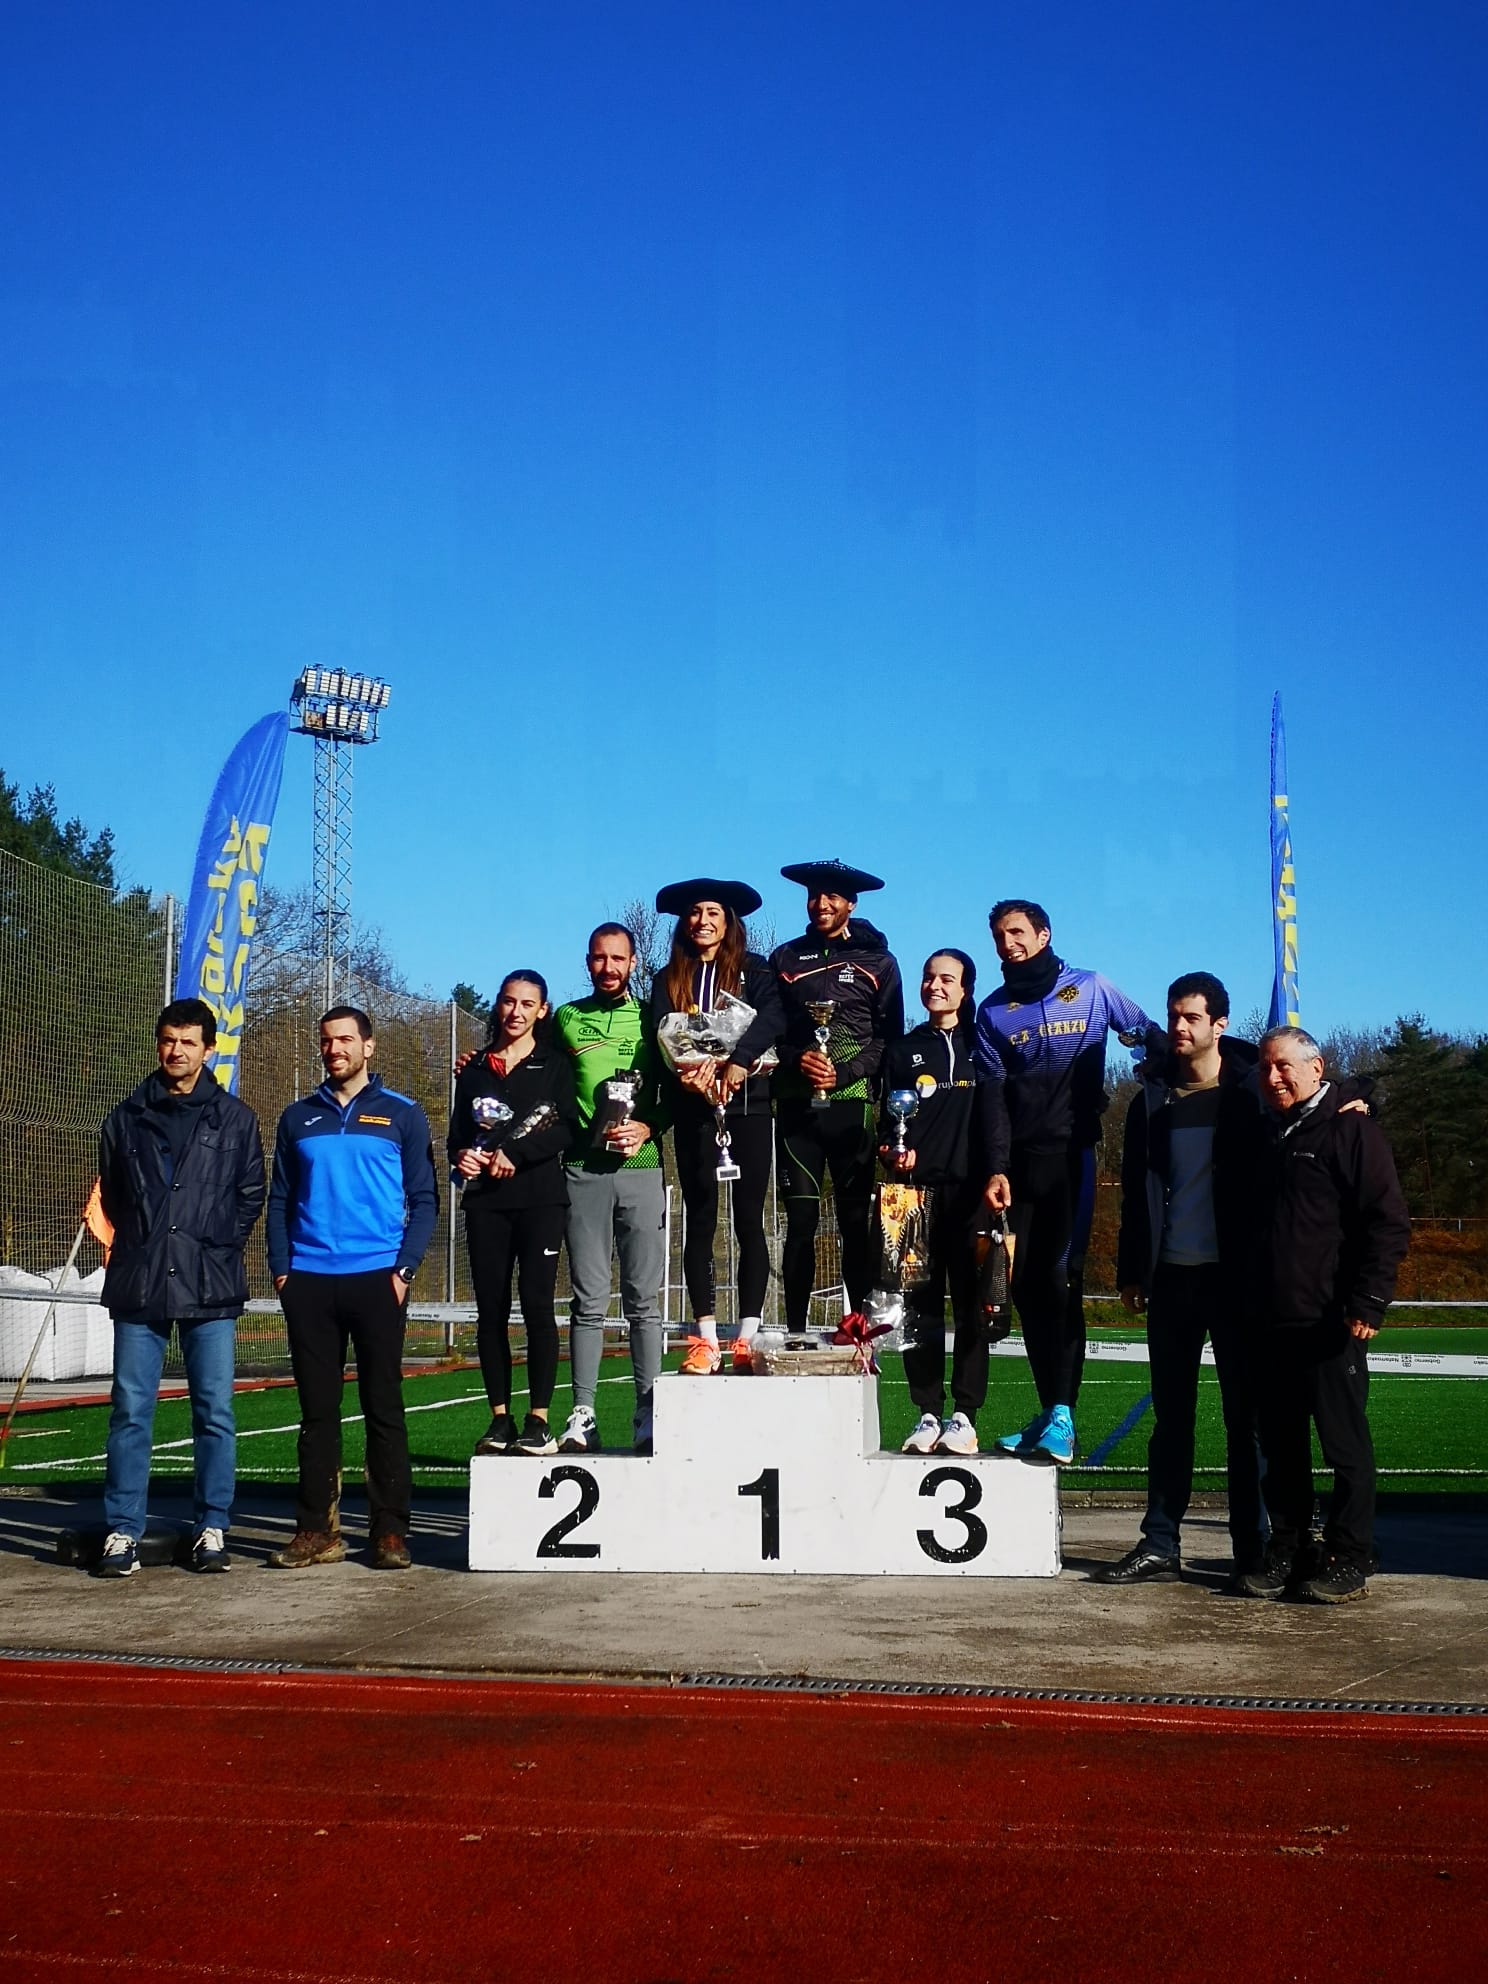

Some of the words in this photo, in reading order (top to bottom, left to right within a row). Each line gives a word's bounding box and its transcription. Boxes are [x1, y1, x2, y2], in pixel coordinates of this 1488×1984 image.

[536, 1465, 600, 1559] 2
[737, 1468, 780, 1560] 1
[916, 1467, 989, 1564] 3
